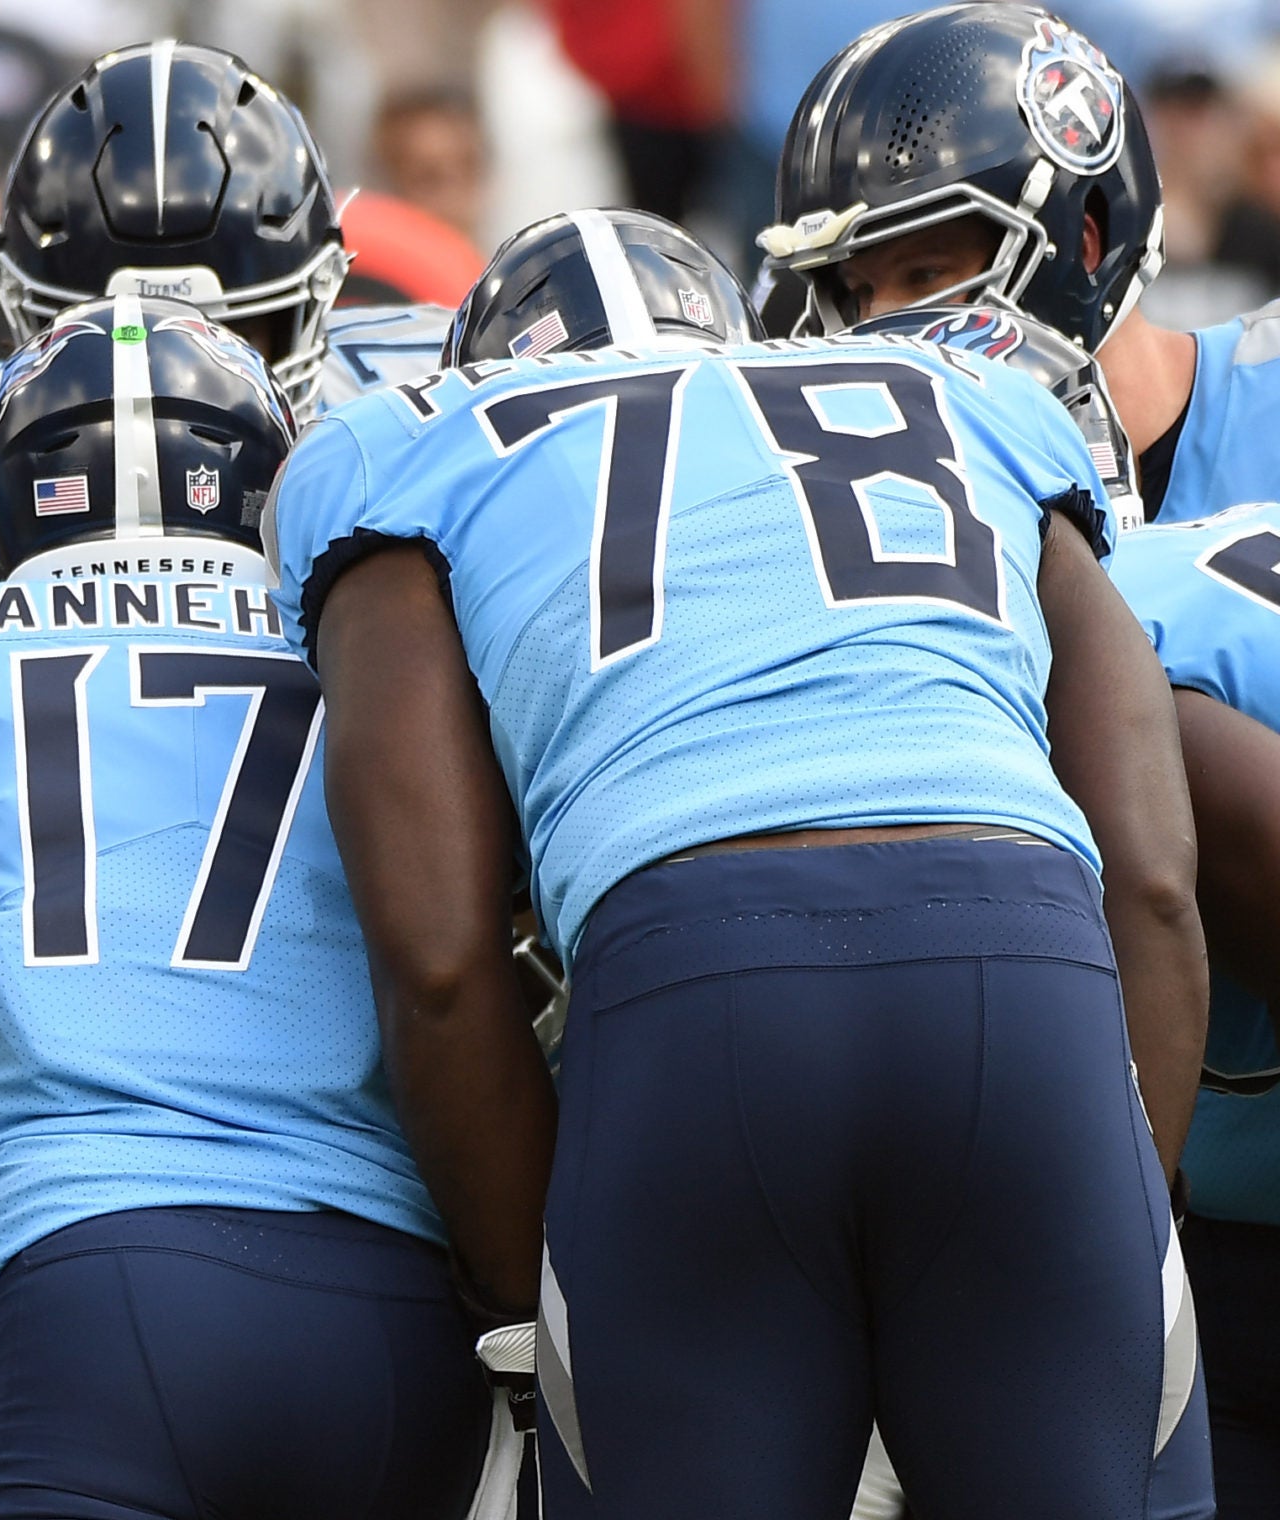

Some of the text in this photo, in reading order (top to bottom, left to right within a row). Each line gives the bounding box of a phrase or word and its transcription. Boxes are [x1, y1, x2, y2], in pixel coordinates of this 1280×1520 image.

[687, 303, 711, 321] NFL
[192, 487, 215, 505] NFL
[472, 356, 1014, 673] 78
[51, 558, 235, 579] TENNESSEE
[10, 646, 322, 972] 17
